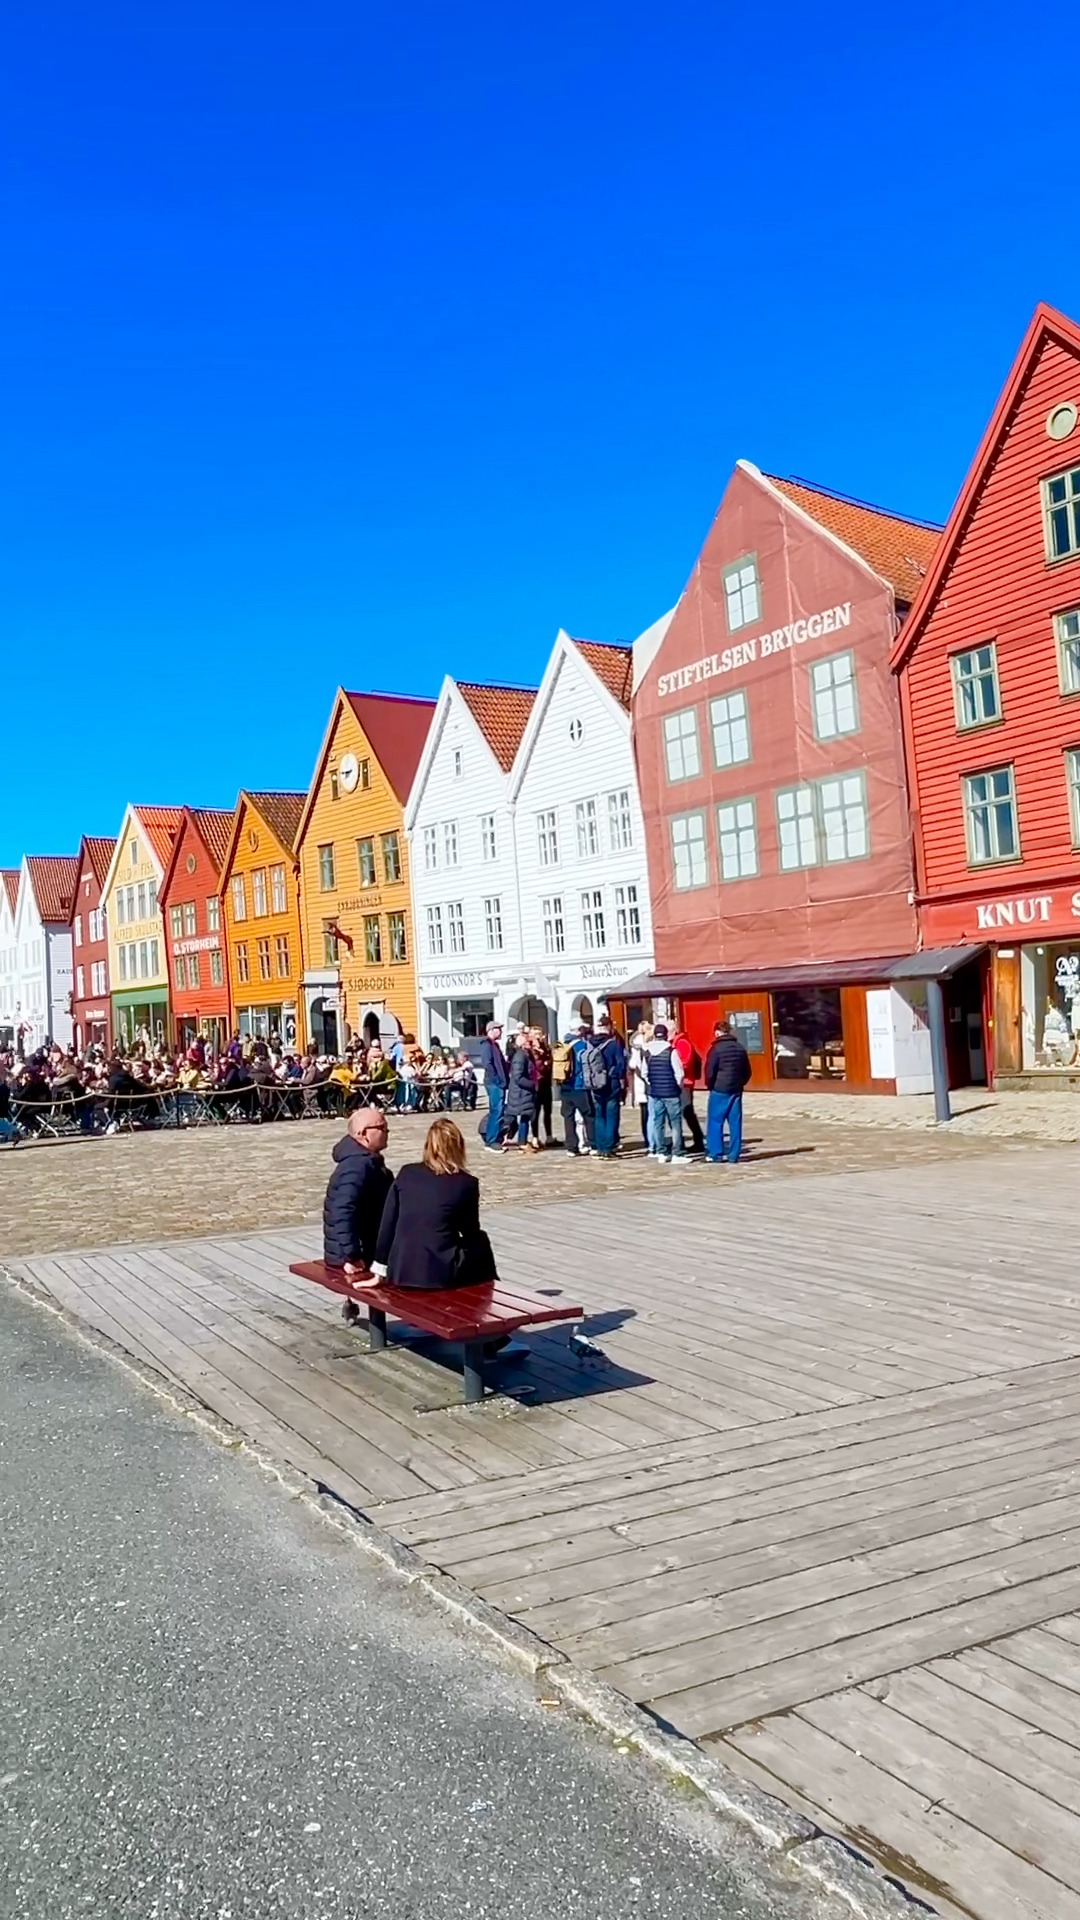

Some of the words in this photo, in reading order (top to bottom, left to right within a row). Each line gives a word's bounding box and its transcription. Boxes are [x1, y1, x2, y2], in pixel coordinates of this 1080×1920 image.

[658, 639, 757, 697] STIFTELSEN
[760, 602, 853, 659] BRYGGEN
[976, 896, 1053, 929] KNUT
[348, 976, 395, 992] SJØBODEN
